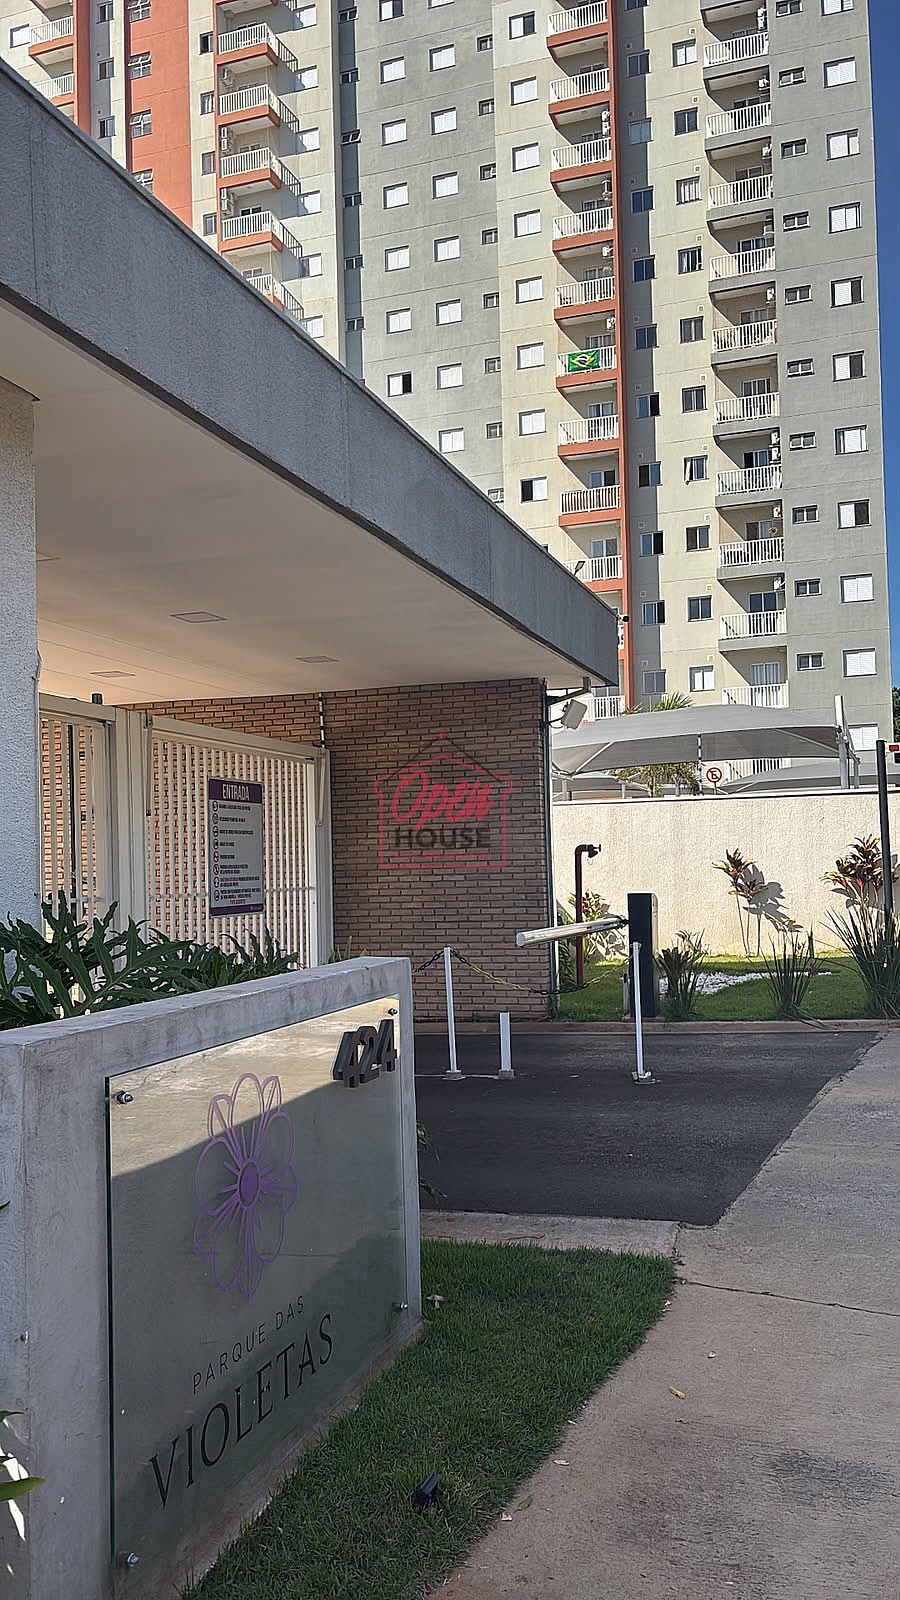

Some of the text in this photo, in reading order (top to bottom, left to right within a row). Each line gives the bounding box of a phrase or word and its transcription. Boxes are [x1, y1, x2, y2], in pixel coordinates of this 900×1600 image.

[222, 783, 250, 801] ENTRADA
[332, 1018, 398, 1088] 424
[193, 1295, 305, 1395] PARQUE DAS
[149, 1314, 334, 1509] VIOLETAS
